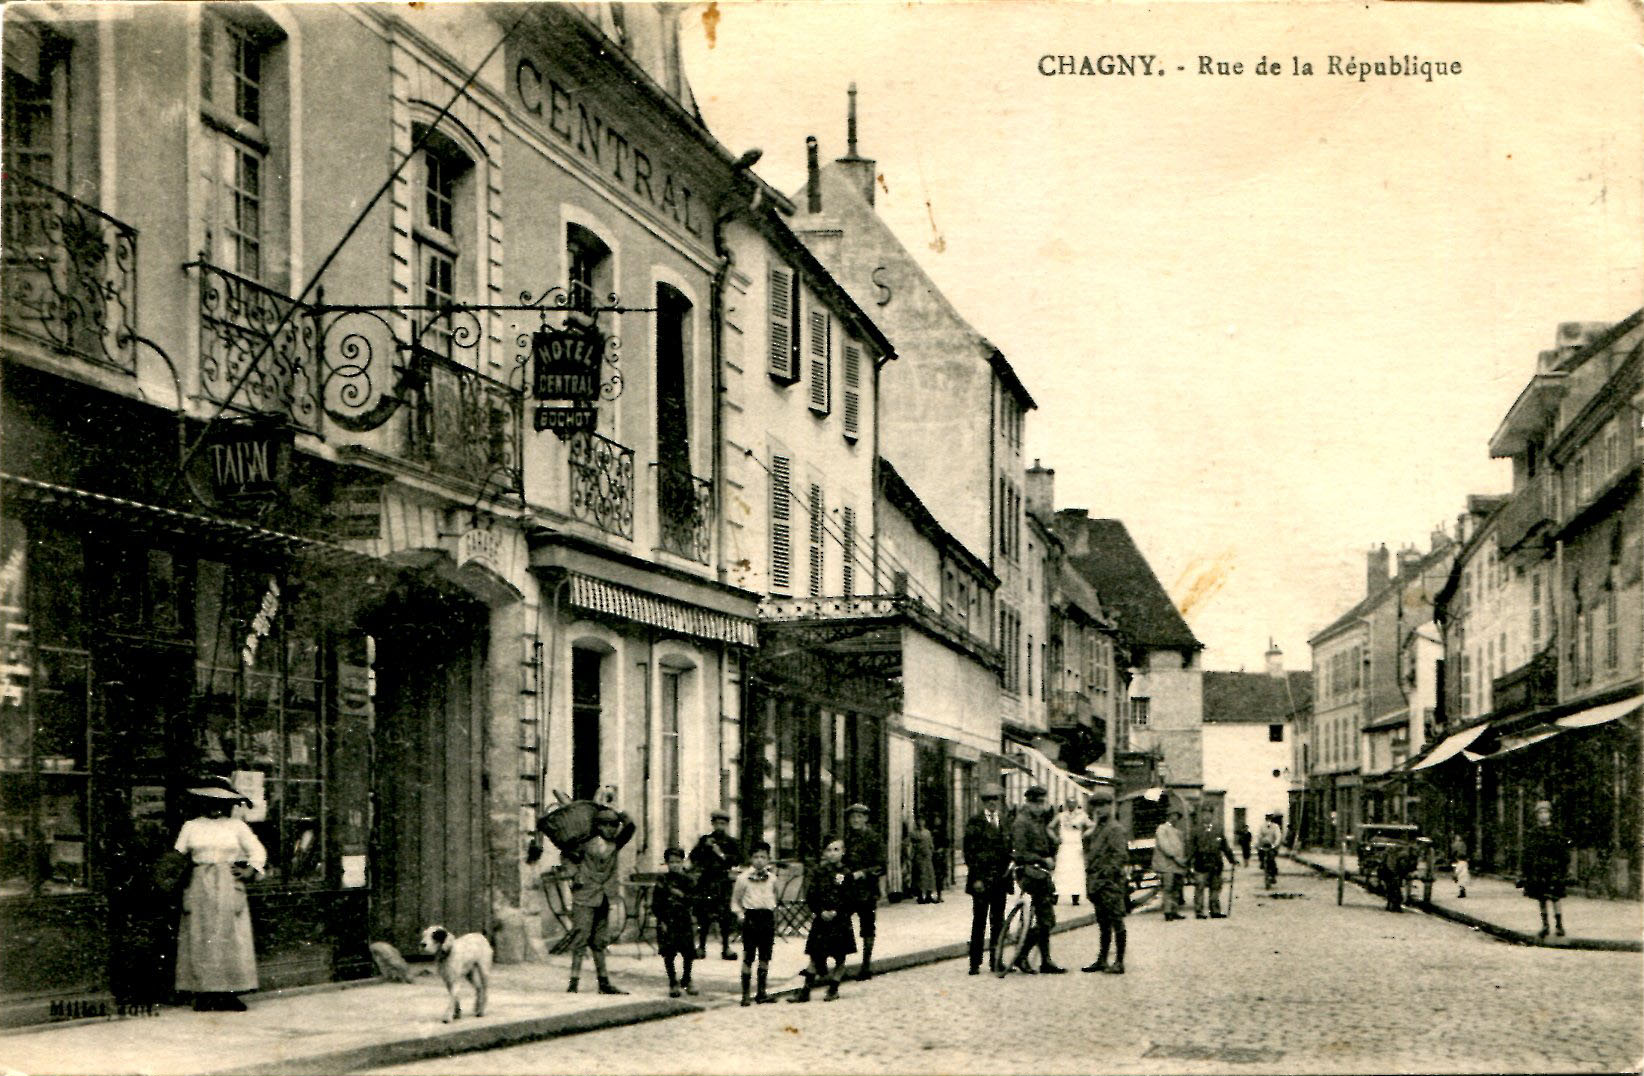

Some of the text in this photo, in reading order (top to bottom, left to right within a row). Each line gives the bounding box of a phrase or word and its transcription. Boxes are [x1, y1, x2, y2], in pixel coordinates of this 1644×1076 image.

[516, 58, 703, 239] CENTRAL
[538, 339, 594, 367] HOTEL
[539, 374, 594, 396] CENTRAL
